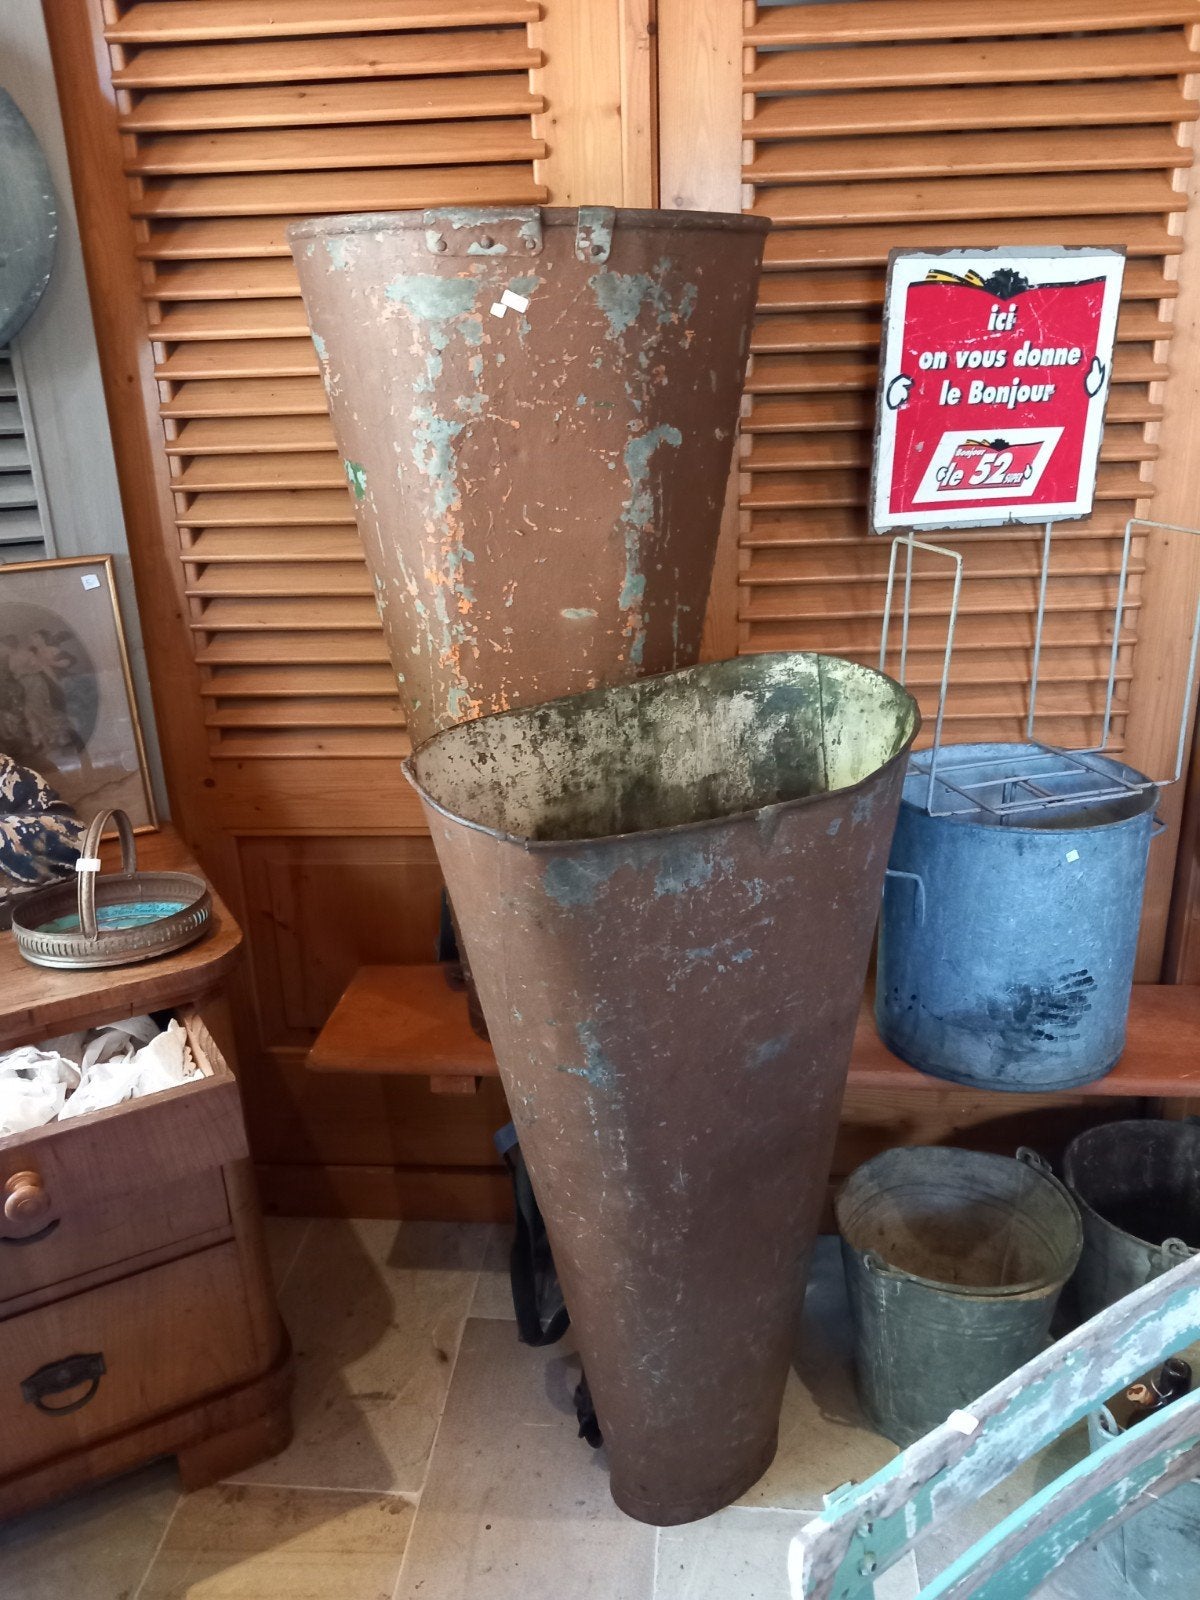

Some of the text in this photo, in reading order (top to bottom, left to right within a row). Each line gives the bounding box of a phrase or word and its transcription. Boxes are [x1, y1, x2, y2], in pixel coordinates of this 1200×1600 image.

[987, 303, 1016, 331] ici
[918, 340, 1082, 370] on vous donne
[939, 377, 1055, 409] le Bonjour
[956, 447, 986, 459] Bonjour
[941, 462, 964, 487] le
[968, 452, 1014, 486] 52
